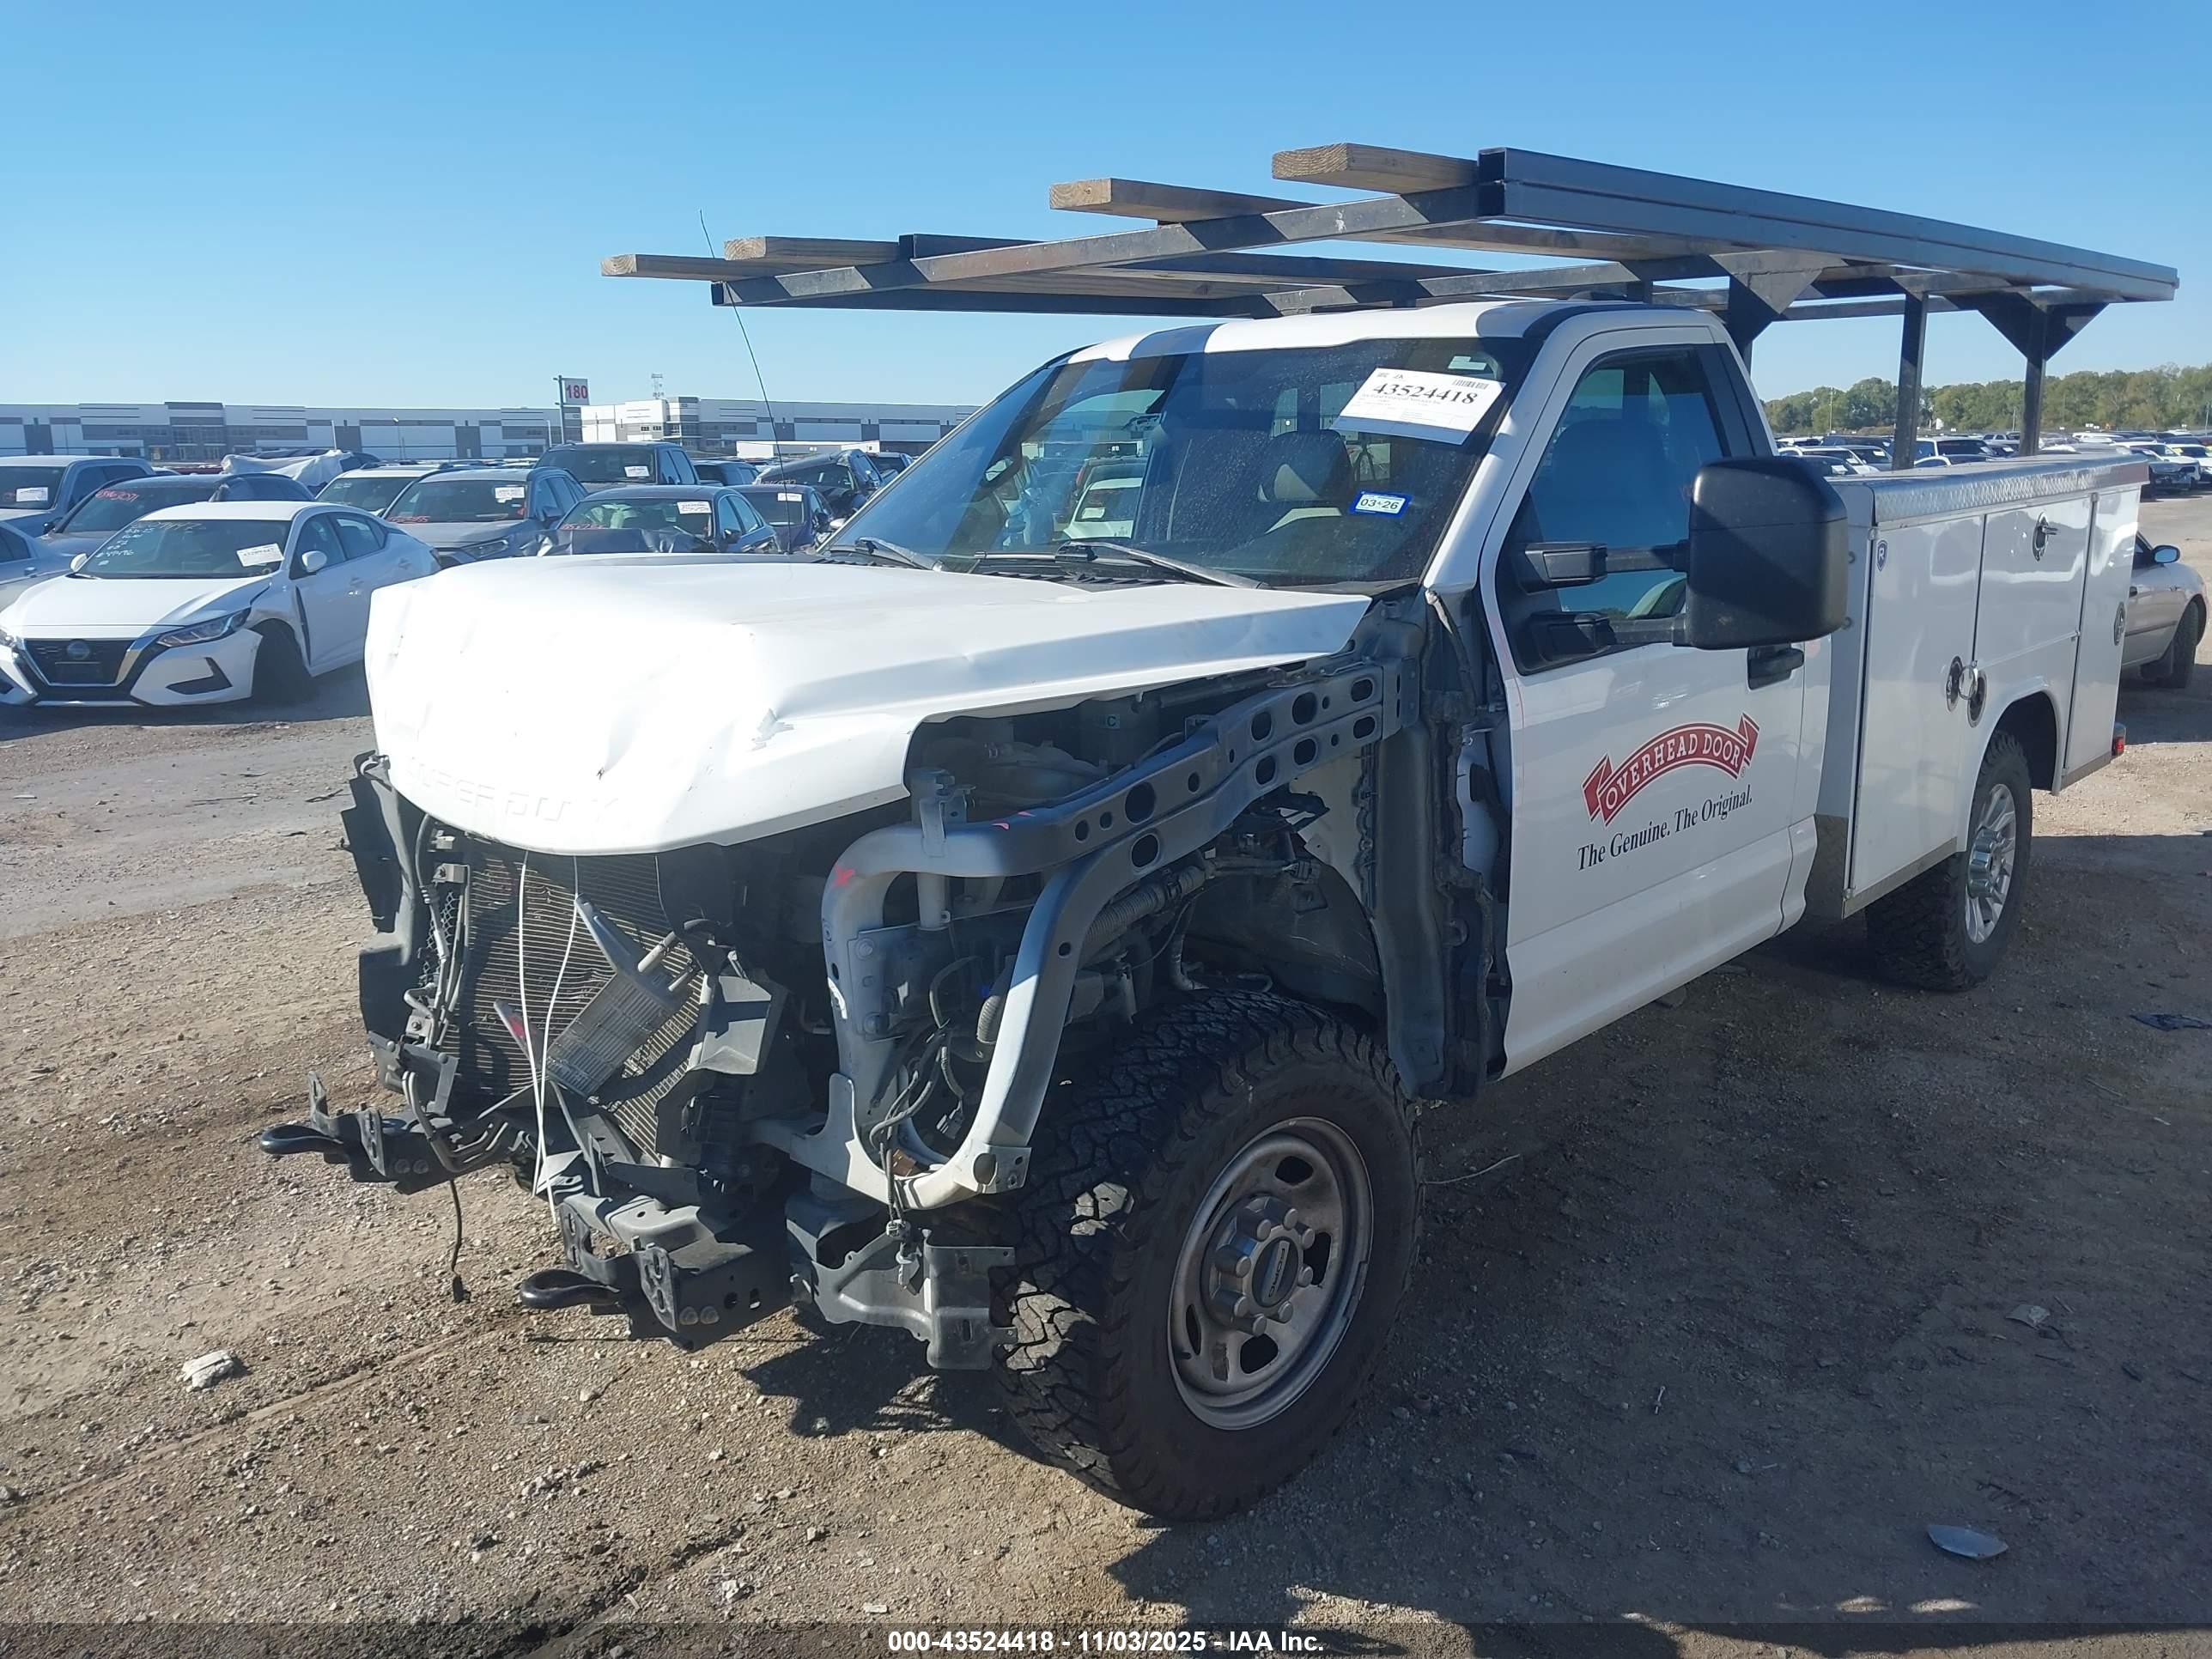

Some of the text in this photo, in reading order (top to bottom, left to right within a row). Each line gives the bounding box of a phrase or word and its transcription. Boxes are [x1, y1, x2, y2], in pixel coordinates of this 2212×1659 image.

[566, 384, 588, 399] 180
[1373, 383, 1479, 404] 43524418
[1360, 498, 1400, 510] 03 26
[1606, 733, 1741, 810] OVERHEAD DOOR
[1577, 784, 1753, 871] The Genuine. The Original.
